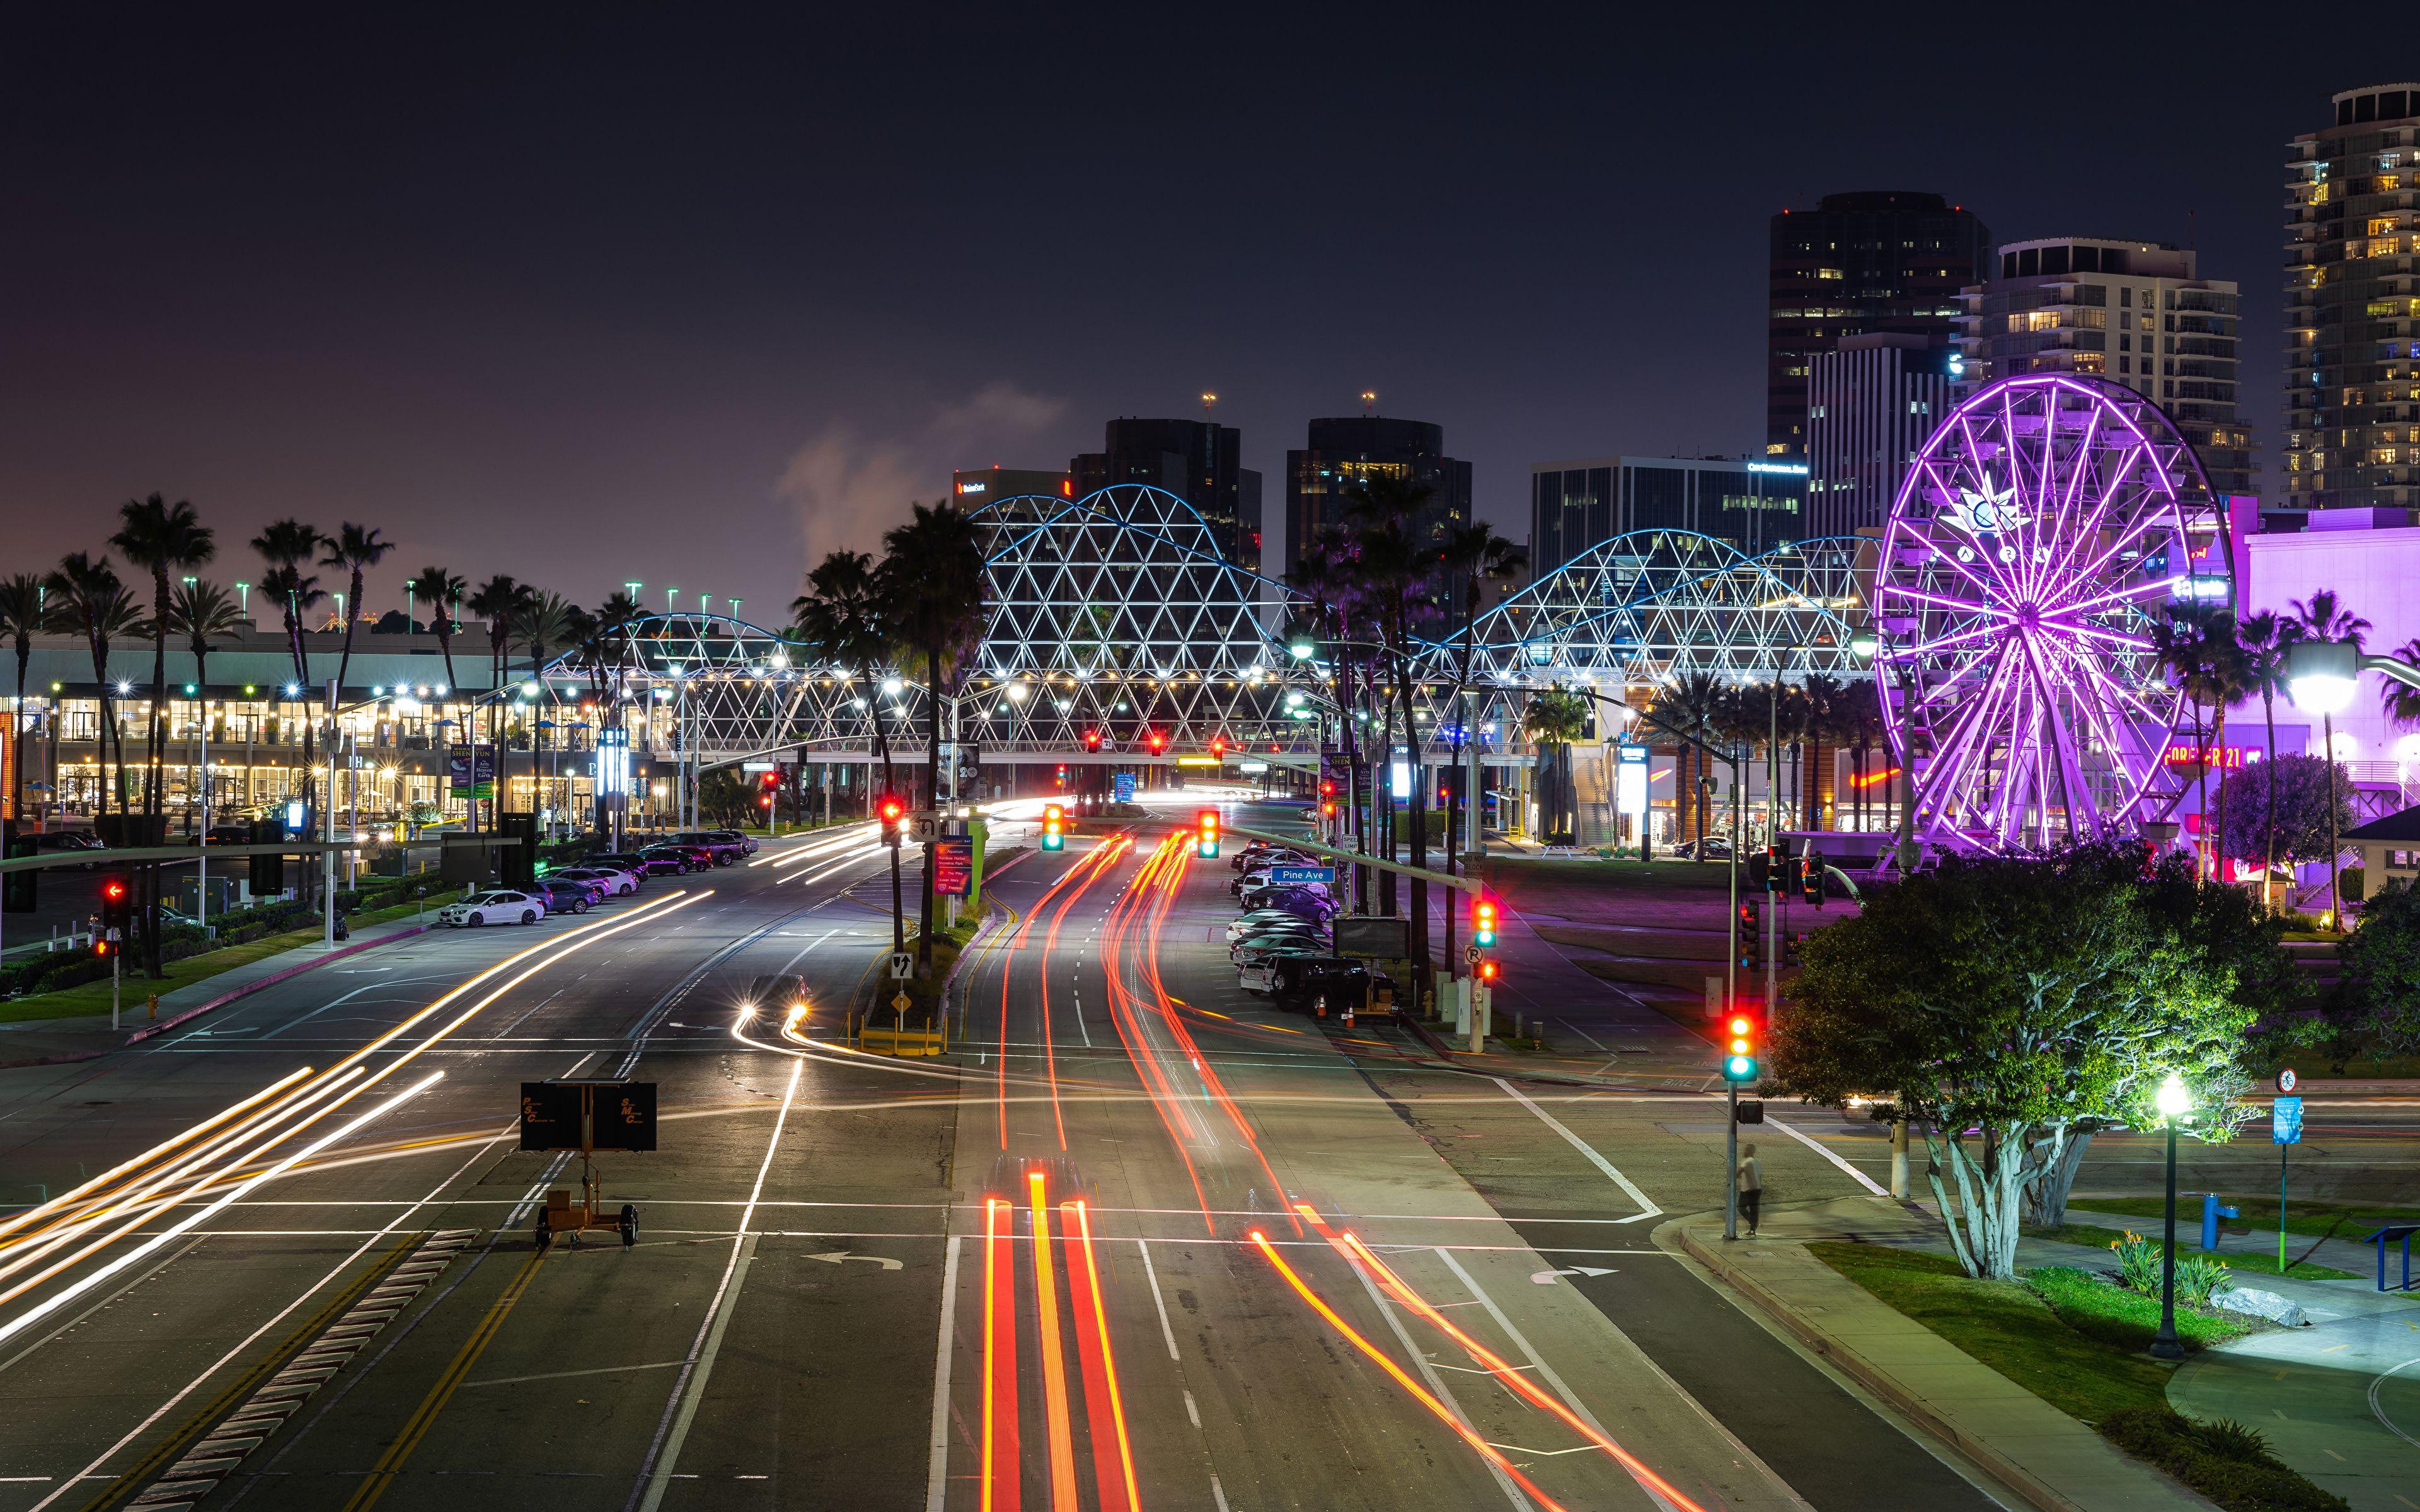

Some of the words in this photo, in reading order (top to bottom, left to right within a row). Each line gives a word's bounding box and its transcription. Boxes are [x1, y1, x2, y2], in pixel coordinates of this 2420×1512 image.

[2227, 748, 2239, 767] 21
[1283, 871, 1303, 879] Pine
[1305, 871, 1323, 879] Ave
[1661, 1079, 1694, 1087] BIKE
